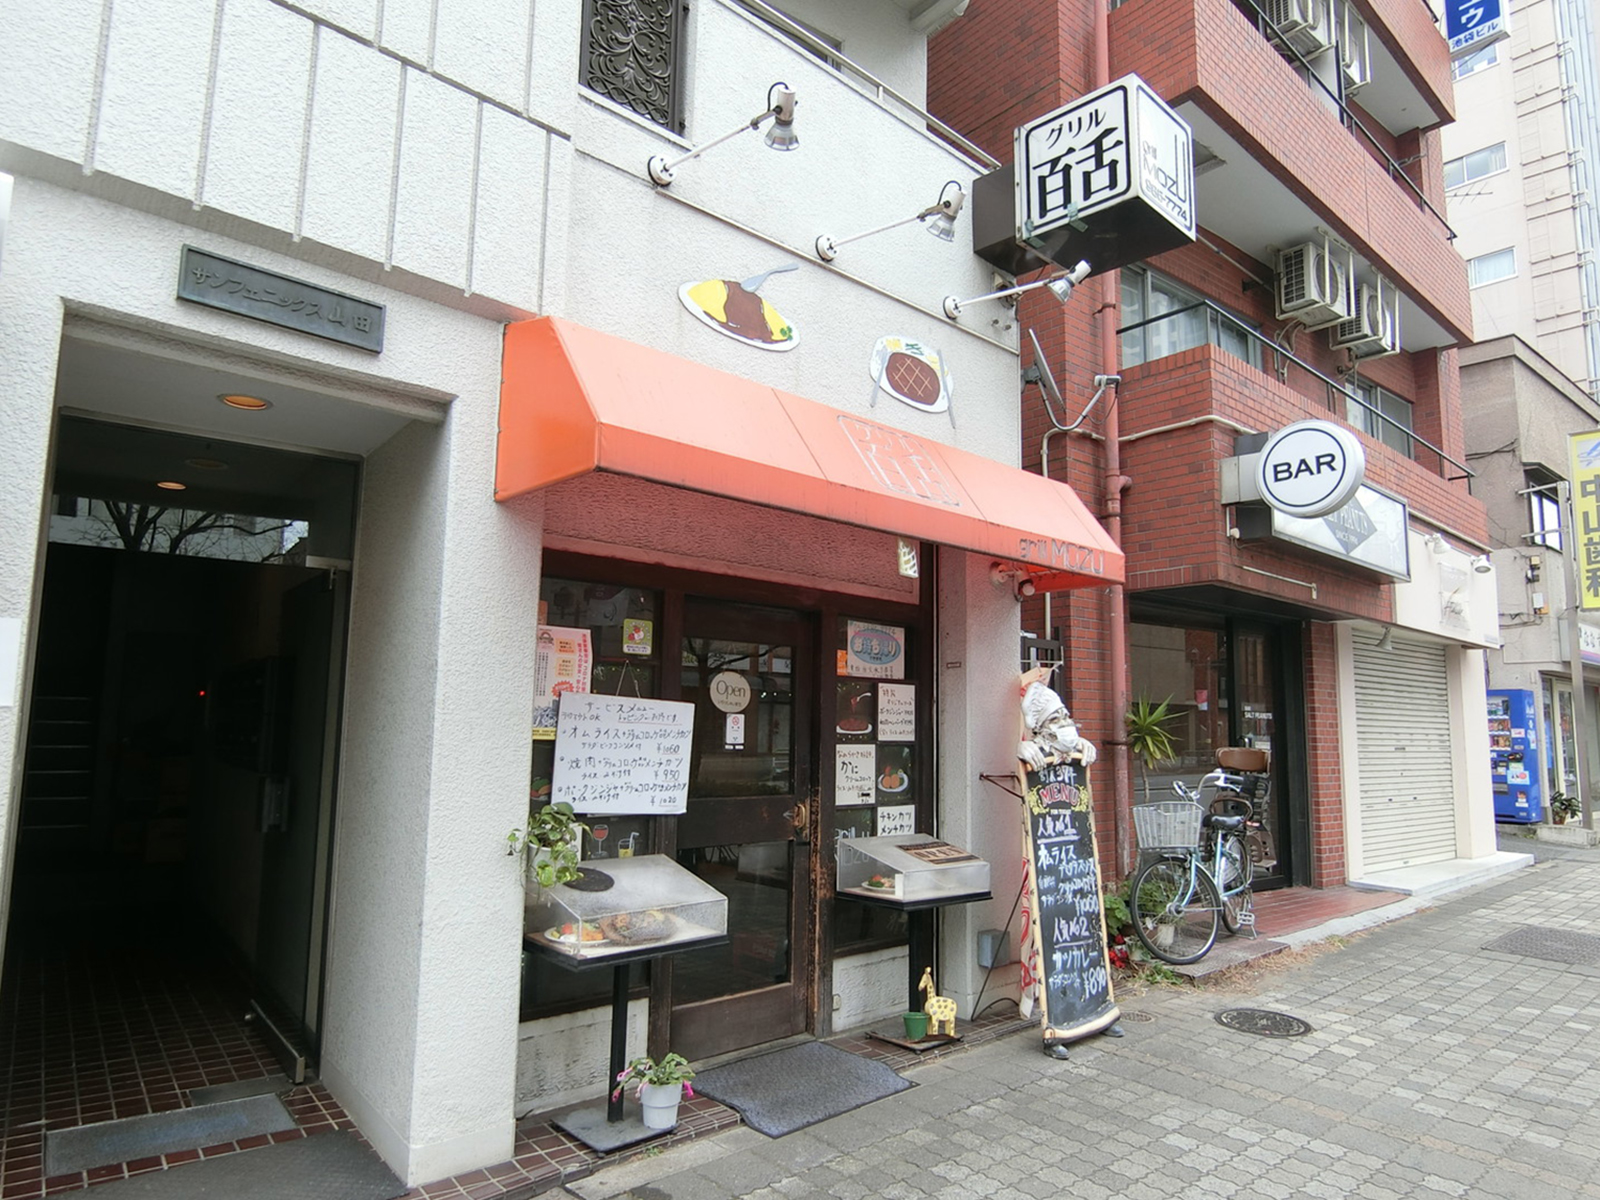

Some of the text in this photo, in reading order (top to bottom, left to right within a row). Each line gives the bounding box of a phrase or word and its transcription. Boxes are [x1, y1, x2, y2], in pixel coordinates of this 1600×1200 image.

[1452, 22, 1499, 48] 池袋ビル
[1046, 108, 1106, 150] グリル
[1032, 126, 1124, 219] 百舌
[1143, 134, 1187, 203] MOZU
[192, 266, 372, 333] サンフェニックス山田
[1272, 453, 1337, 483] BAR
[1019, 538, 1104, 575] grill MOZU
[716, 680, 746, 700] Open
[585, 701, 655, 714] サービスメニュー
[841, 761, 859, 775] かに
[1039, 783, 1080, 807] MENU
[880, 811, 912, 822] チキンカツ
[880, 824, 912, 835] メンチカツ
[1038, 844, 1077, 870] オムライス
[1052, 948, 1098, 970] カツカレー
[1082, 966, 1106, 999] ¥890
